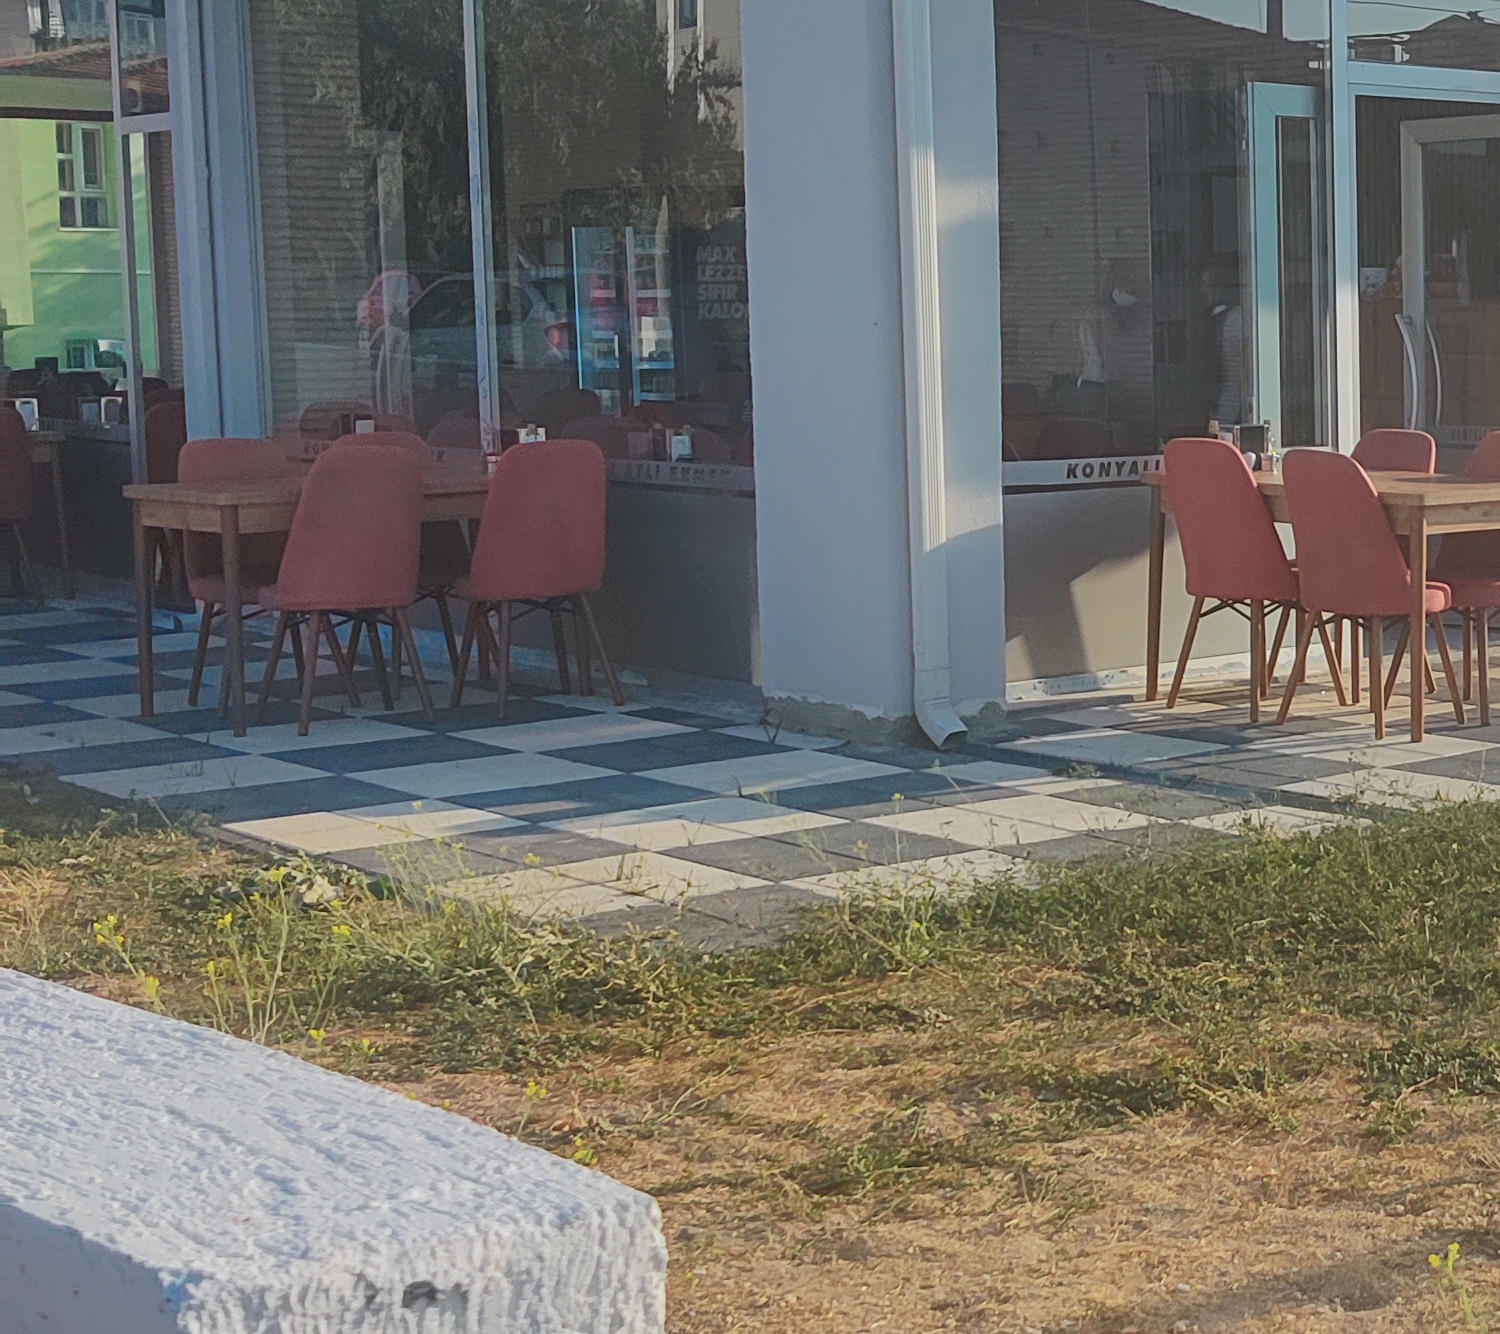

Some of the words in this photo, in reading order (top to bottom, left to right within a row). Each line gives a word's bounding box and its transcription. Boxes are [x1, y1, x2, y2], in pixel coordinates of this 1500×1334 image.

[696, 245, 737, 263] MAX
[697, 264, 747, 281] LEZZE
[697, 301, 748, 321] KALO
